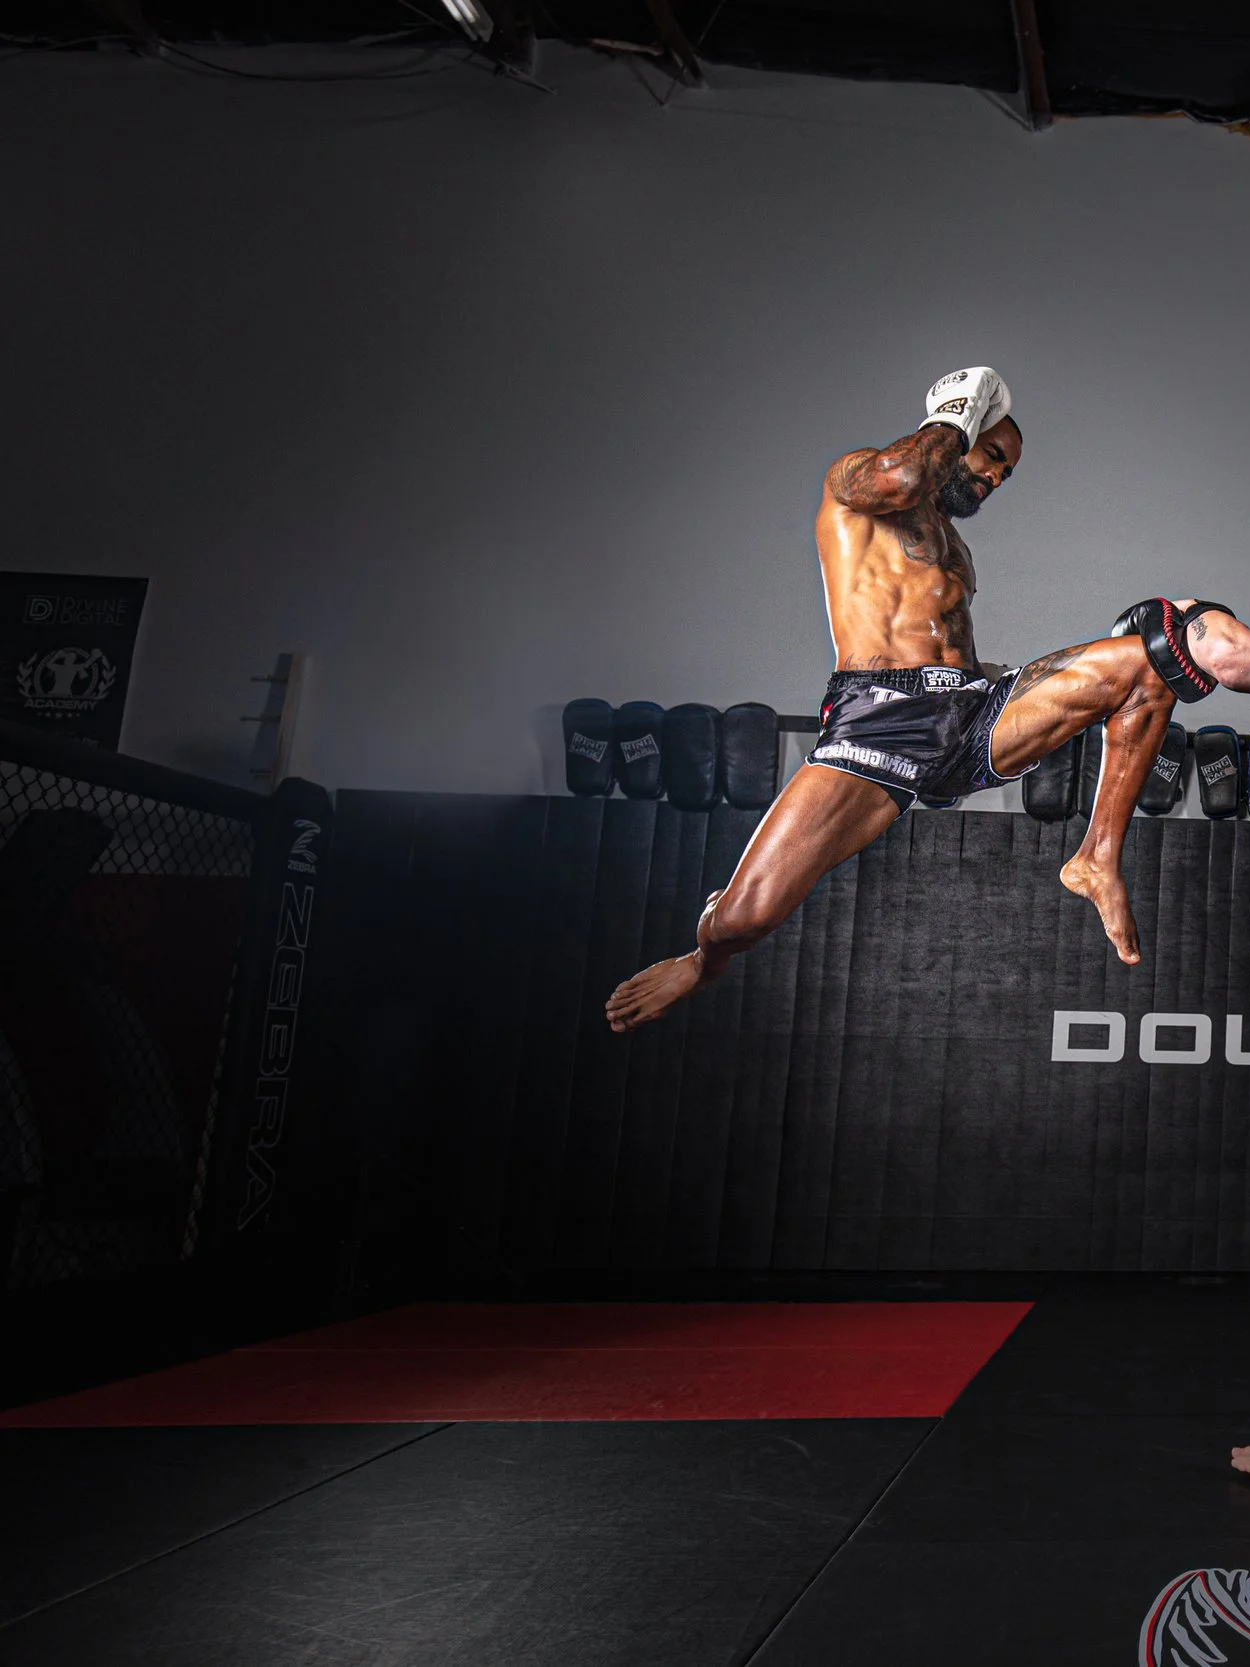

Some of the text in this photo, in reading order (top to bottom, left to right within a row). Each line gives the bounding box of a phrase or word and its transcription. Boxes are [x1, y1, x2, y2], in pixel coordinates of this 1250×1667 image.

[62, 597, 129, 613] DIVINE
[60, 611, 125, 626] DIGITAL
[928, 678, 960, 686] STYLE
[24, 699, 99, 711] ACADEMY
[622, 736, 653, 752] RING
[1156, 757, 1176, 771] ING
[1203, 758, 1230, 775] RING
[1152, 765, 1172, 779] AGE
[288, 859, 316, 875] ZEBRA
[238, 882, 315, 1231] ZEBRA
